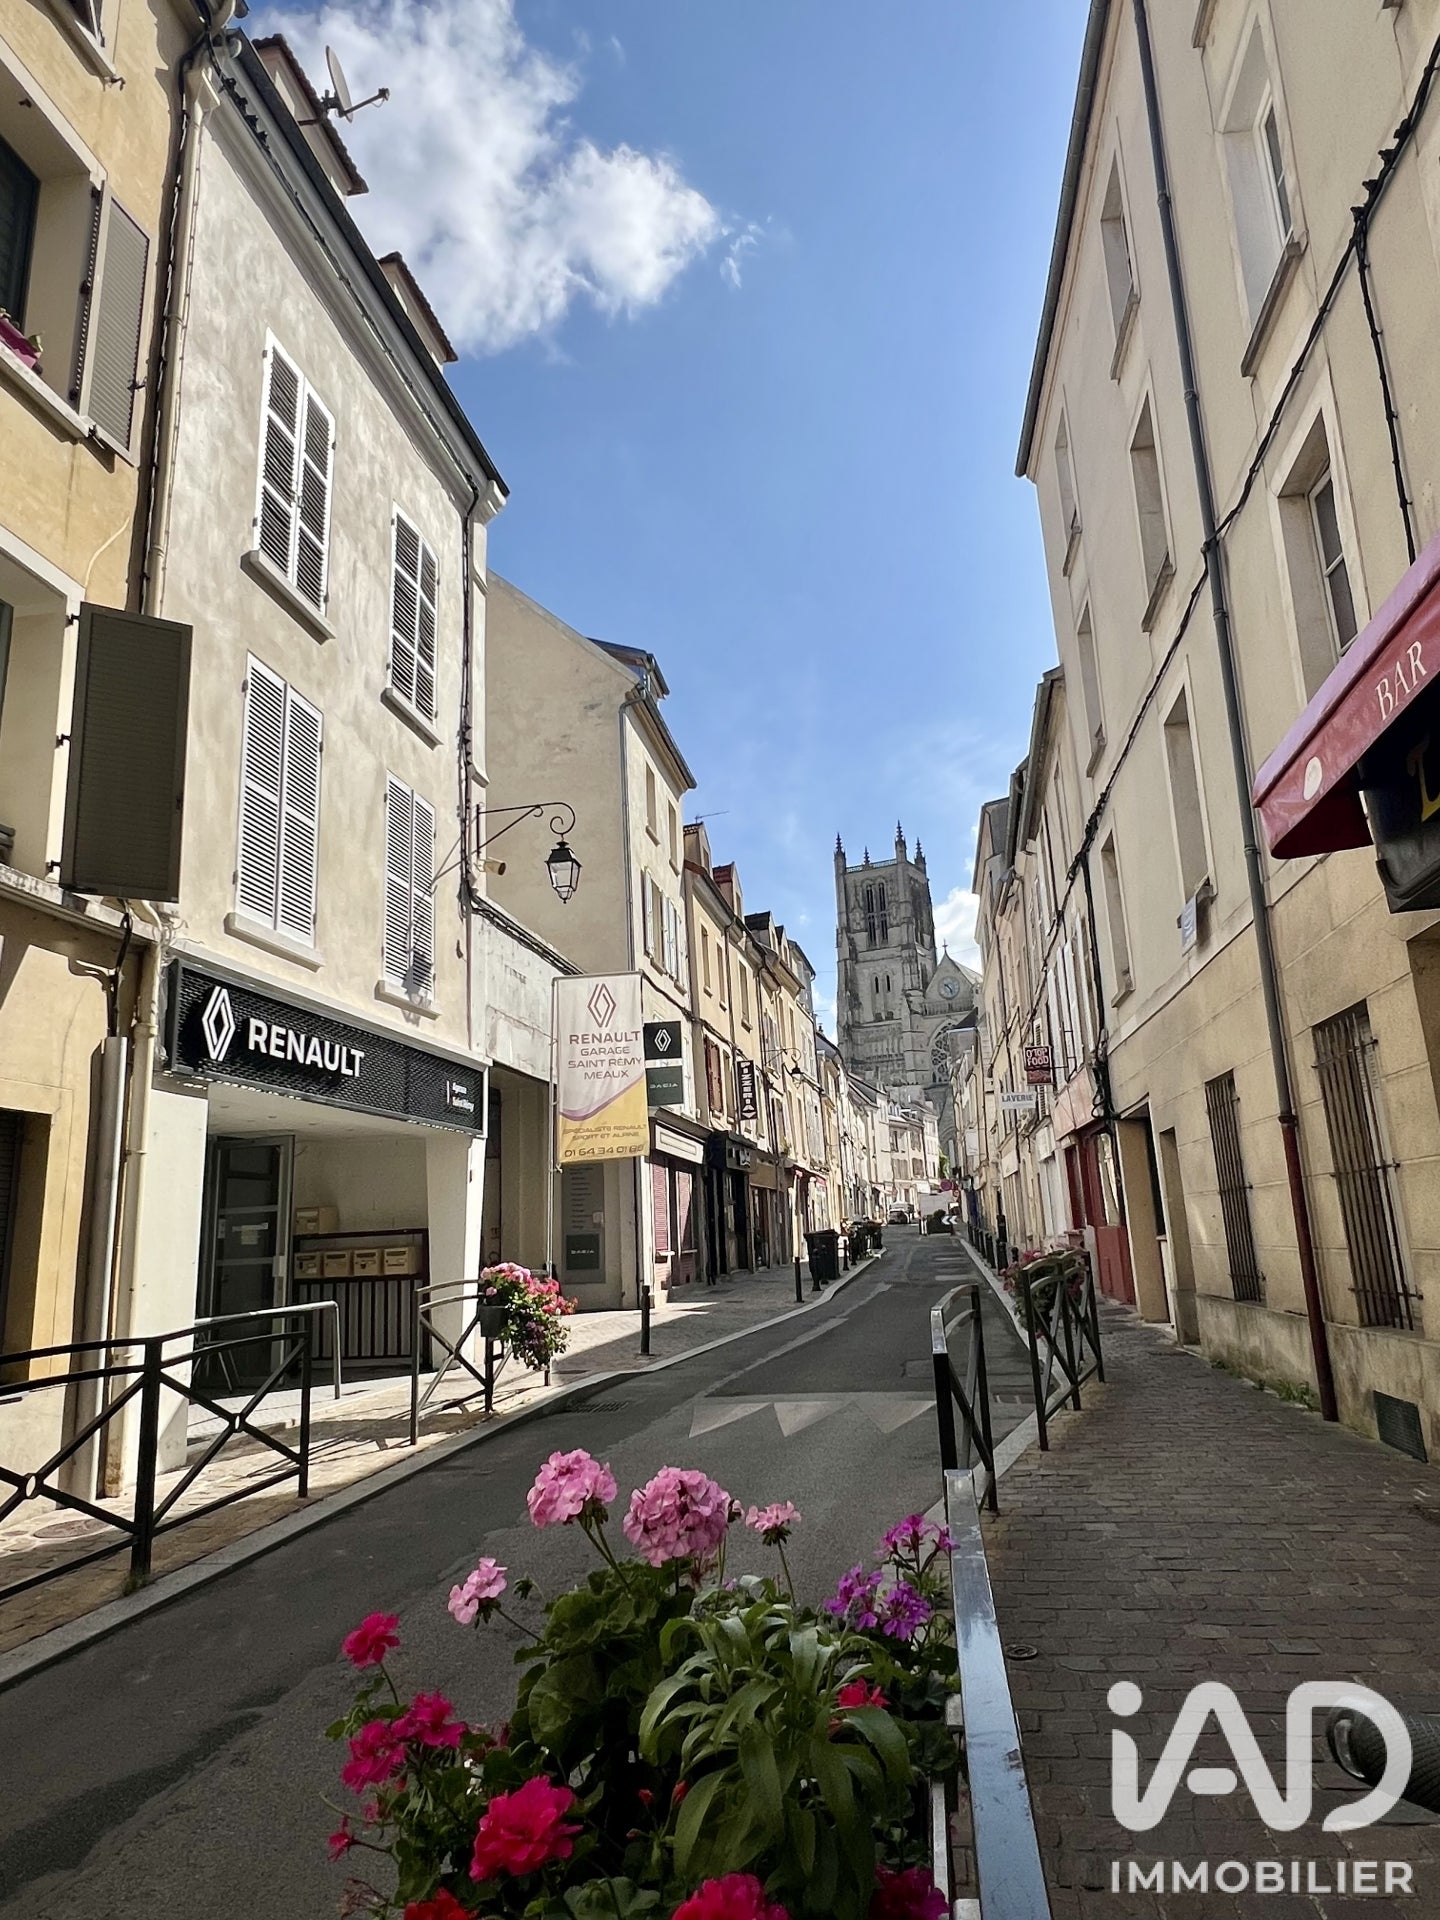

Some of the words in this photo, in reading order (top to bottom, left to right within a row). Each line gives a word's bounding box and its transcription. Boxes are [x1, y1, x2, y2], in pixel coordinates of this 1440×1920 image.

[1374, 640, 1428, 721] BAR
[569, 1030, 641, 1045] RENAULT
[247, 1017, 365, 1078] RENAULT
[580, 1046, 631, 1057] GARAGE
[568, 1059, 606, 1069] SAINT
[608, 1056, 642, 1067] RÉMY
[1027, 1056, 1049, 1066] FOOD
[583, 1069, 629, 1080] MEAUX
[740, 1061, 755, 1112] PIZZERIA
[1002, 1094, 1033, 1102] LAVERIE
[613, 1123, 647, 1132] RENAULT
[572, 1133, 599, 1141] SPORT
[564, 1149, 576, 1158] 01
[578, 1147, 595, 1156] 64
[597, 1146, 615, 1155] 34
[616, 1145, 628, 1154] 01
